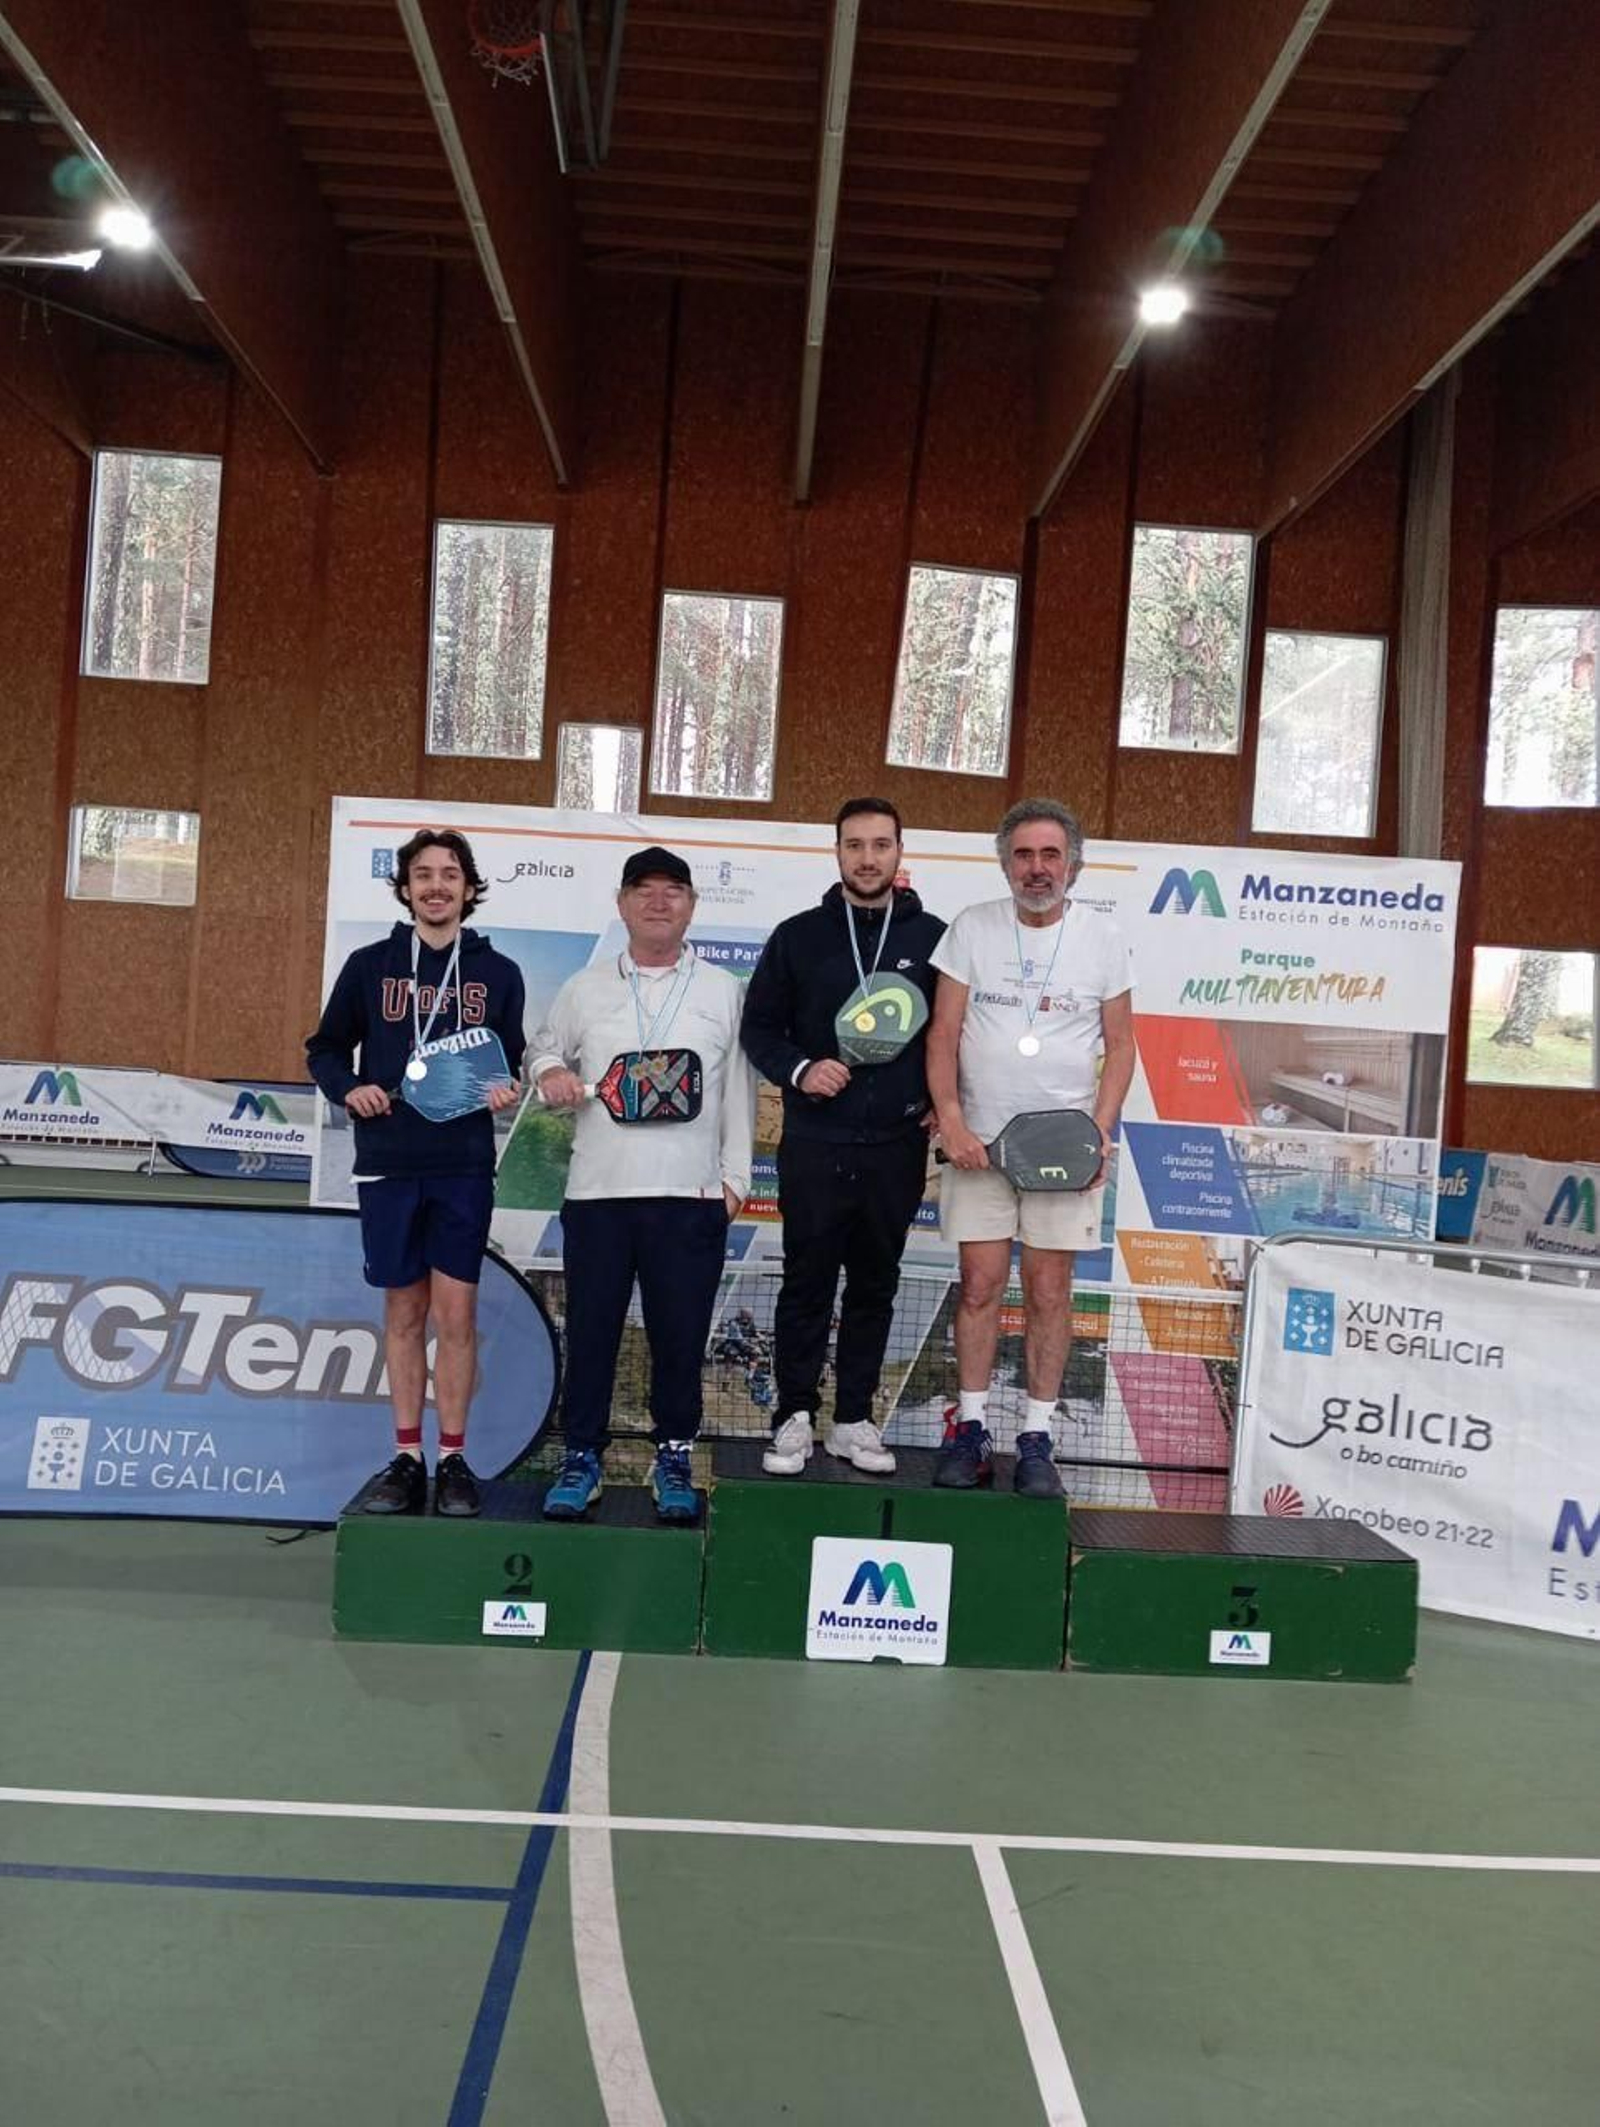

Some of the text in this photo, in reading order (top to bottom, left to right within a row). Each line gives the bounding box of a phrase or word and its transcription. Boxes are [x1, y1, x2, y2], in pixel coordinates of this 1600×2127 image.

[497, 860, 575, 883] galicia
[1241, 874, 1445, 913] Manzaneda
[1238, 906, 1444, 933] Estación de Montaña
[696, 946, 763, 961] Bike Par
[1240, 948, 1316, 970] Parque
[383, 978, 412, 1021] U
[463, 982, 488, 1025] S
[1179, 973, 1387, 1006] MULTIAVENTURA
[3, 1108, 100, 1125] Manzaneda
[207, 1122, 305, 1142] Manzaneda
[1346, 1300, 1443, 1332] XUNTA
[0, 1277, 440, 1402] FGTen
[1345, 1327, 1505, 1369] DE GALICIA
[1270, 1393, 1493, 1452] galicia
[101, 1427, 217, 1458] XUNTA
[95, 1460, 287, 1495] DE GALICIA
[1340, 1445, 1468, 1479] o bo camiño
[503, 1553, 533, 1596] 2
[818, 1610, 938, 1632] Manzaneda
[1228, 1586, 1259, 1628] 3
[816, 1630, 938, 1645] Estación de Montaña
